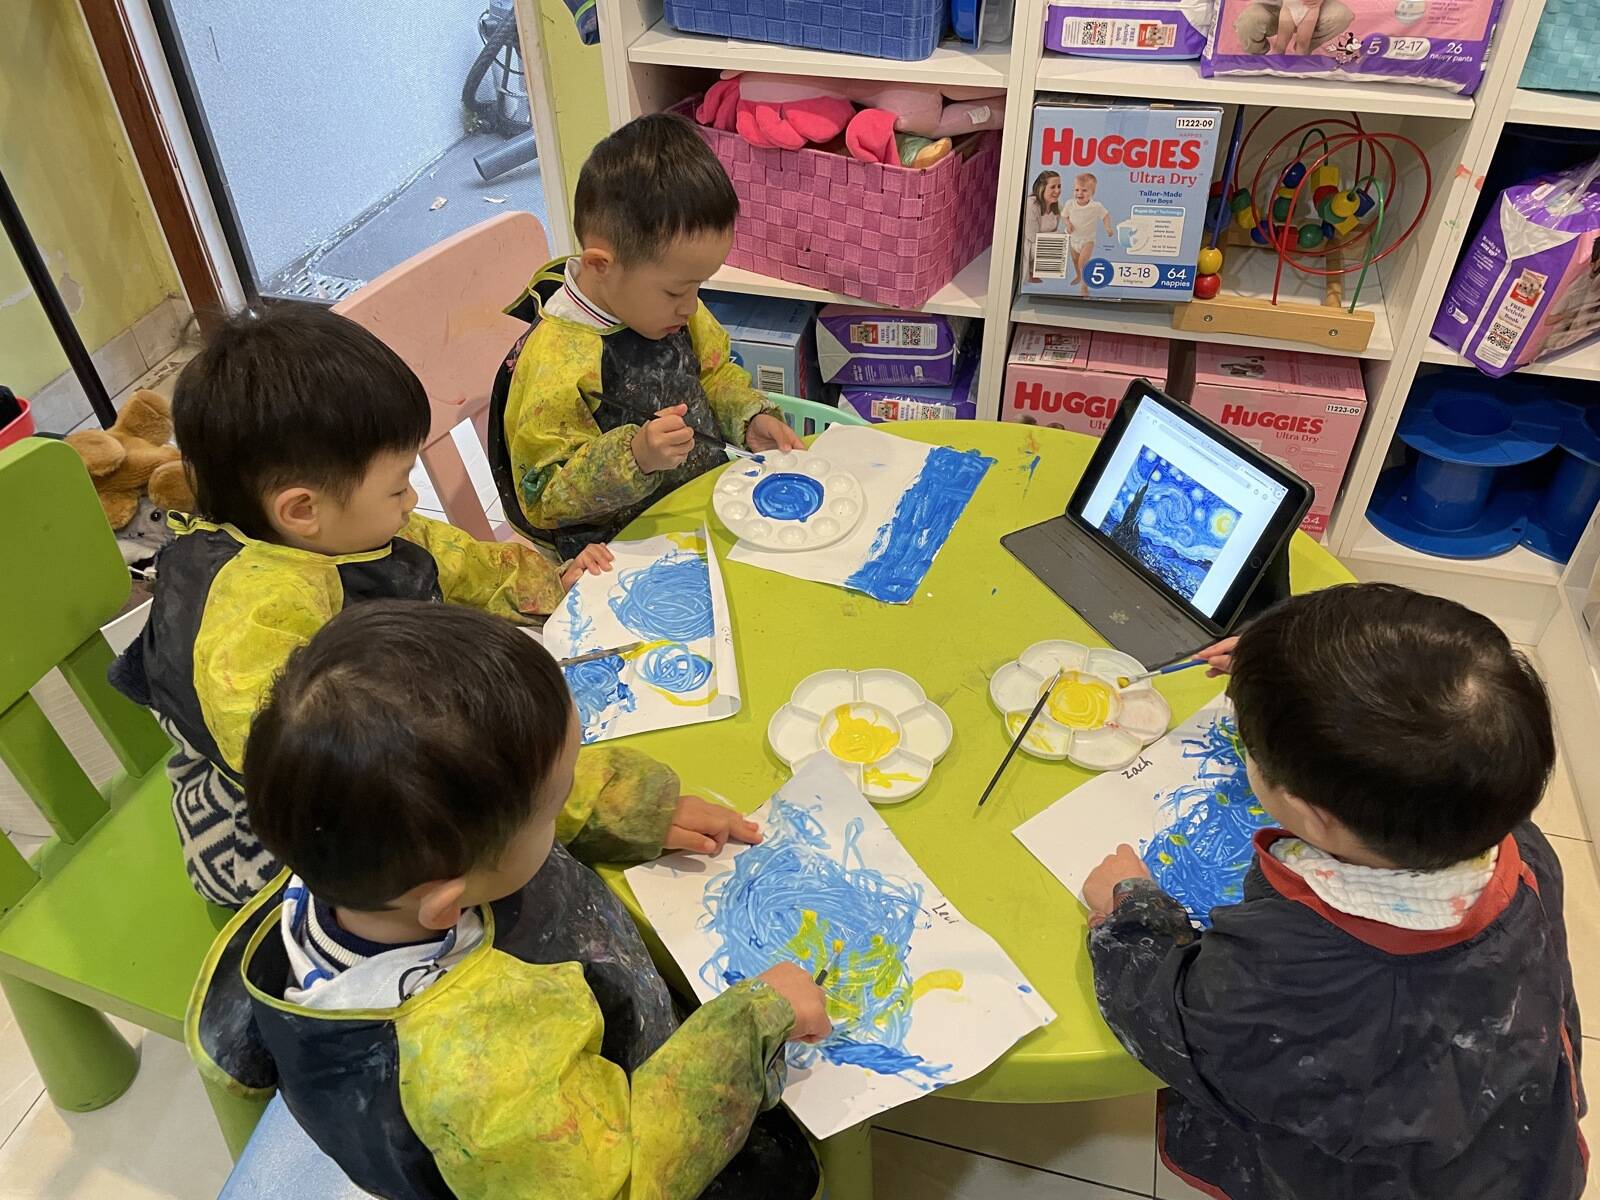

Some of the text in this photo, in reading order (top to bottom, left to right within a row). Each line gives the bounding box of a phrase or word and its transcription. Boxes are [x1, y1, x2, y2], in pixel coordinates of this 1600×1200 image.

[1366, 40, 1382, 55] 5
[1393, 40, 1424, 52] 12-17
[1446, 42, 1463, 55] 26
[1452, 54, 1473, 63] pants
[1177, 119, 1213, 128] 11222-09
[1129, 171, 1198, 188] Ultra Dry
[1139, 190, 1183, 198] Tailor-Made
[1091, 266, 1151, 285] 5 13-18
[1167, 267, 1187, 280] 64
[1160, 279, 1190, 288] nappies
[1013, 381, 1117, 419] HUGGI
[1326, 404, 1360, 415] 11223-09
[1089, 419, 1107, 431] Ult
[1275, 431, 1320, 444] Ultra Dry
